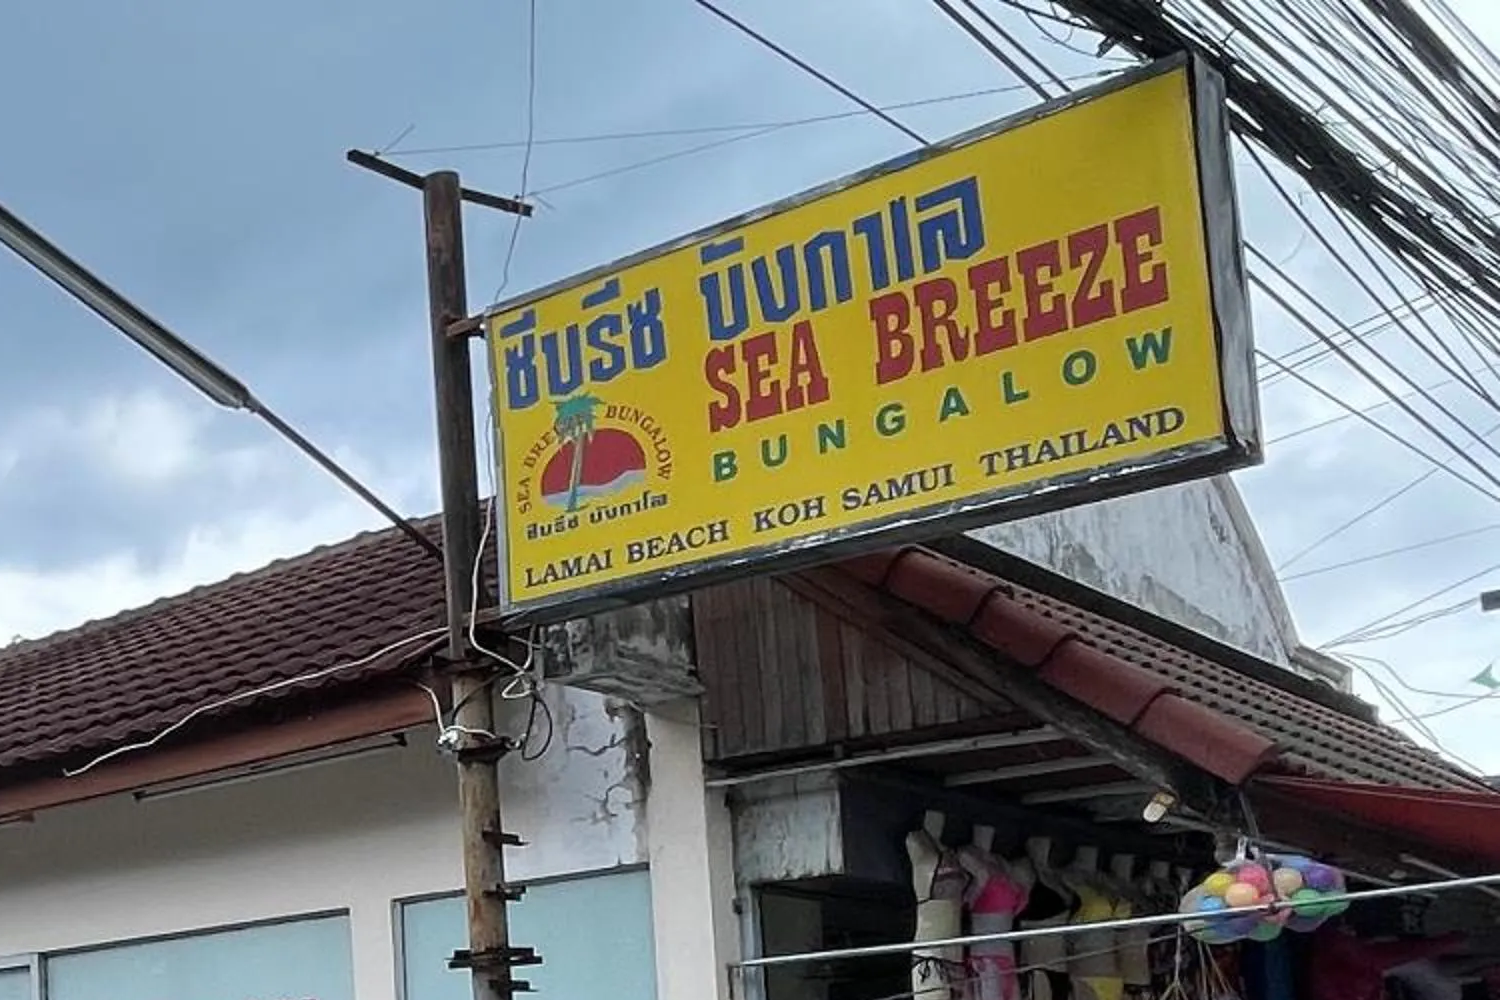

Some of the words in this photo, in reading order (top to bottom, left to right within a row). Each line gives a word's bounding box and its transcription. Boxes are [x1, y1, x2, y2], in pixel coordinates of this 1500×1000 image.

[699, 175, 986, 341] บังกาโล
[704, 319, 830, 433] SEA
[869, 205, 1170, 385] BREEZE
[516, 476, 533, 514] SEA
[605, 404, 673, 481] BUNGALOW
[713, 327, 1173, 482] BUNGALOW
[525, 549, 613, 588] LAMAI
[626, 520, 730, 564] BEACH
[753, 496, 827, 533] KOH
[841, 463, 956, 511] SAMUI
[979, 407, 1186, 476] THAILAND
